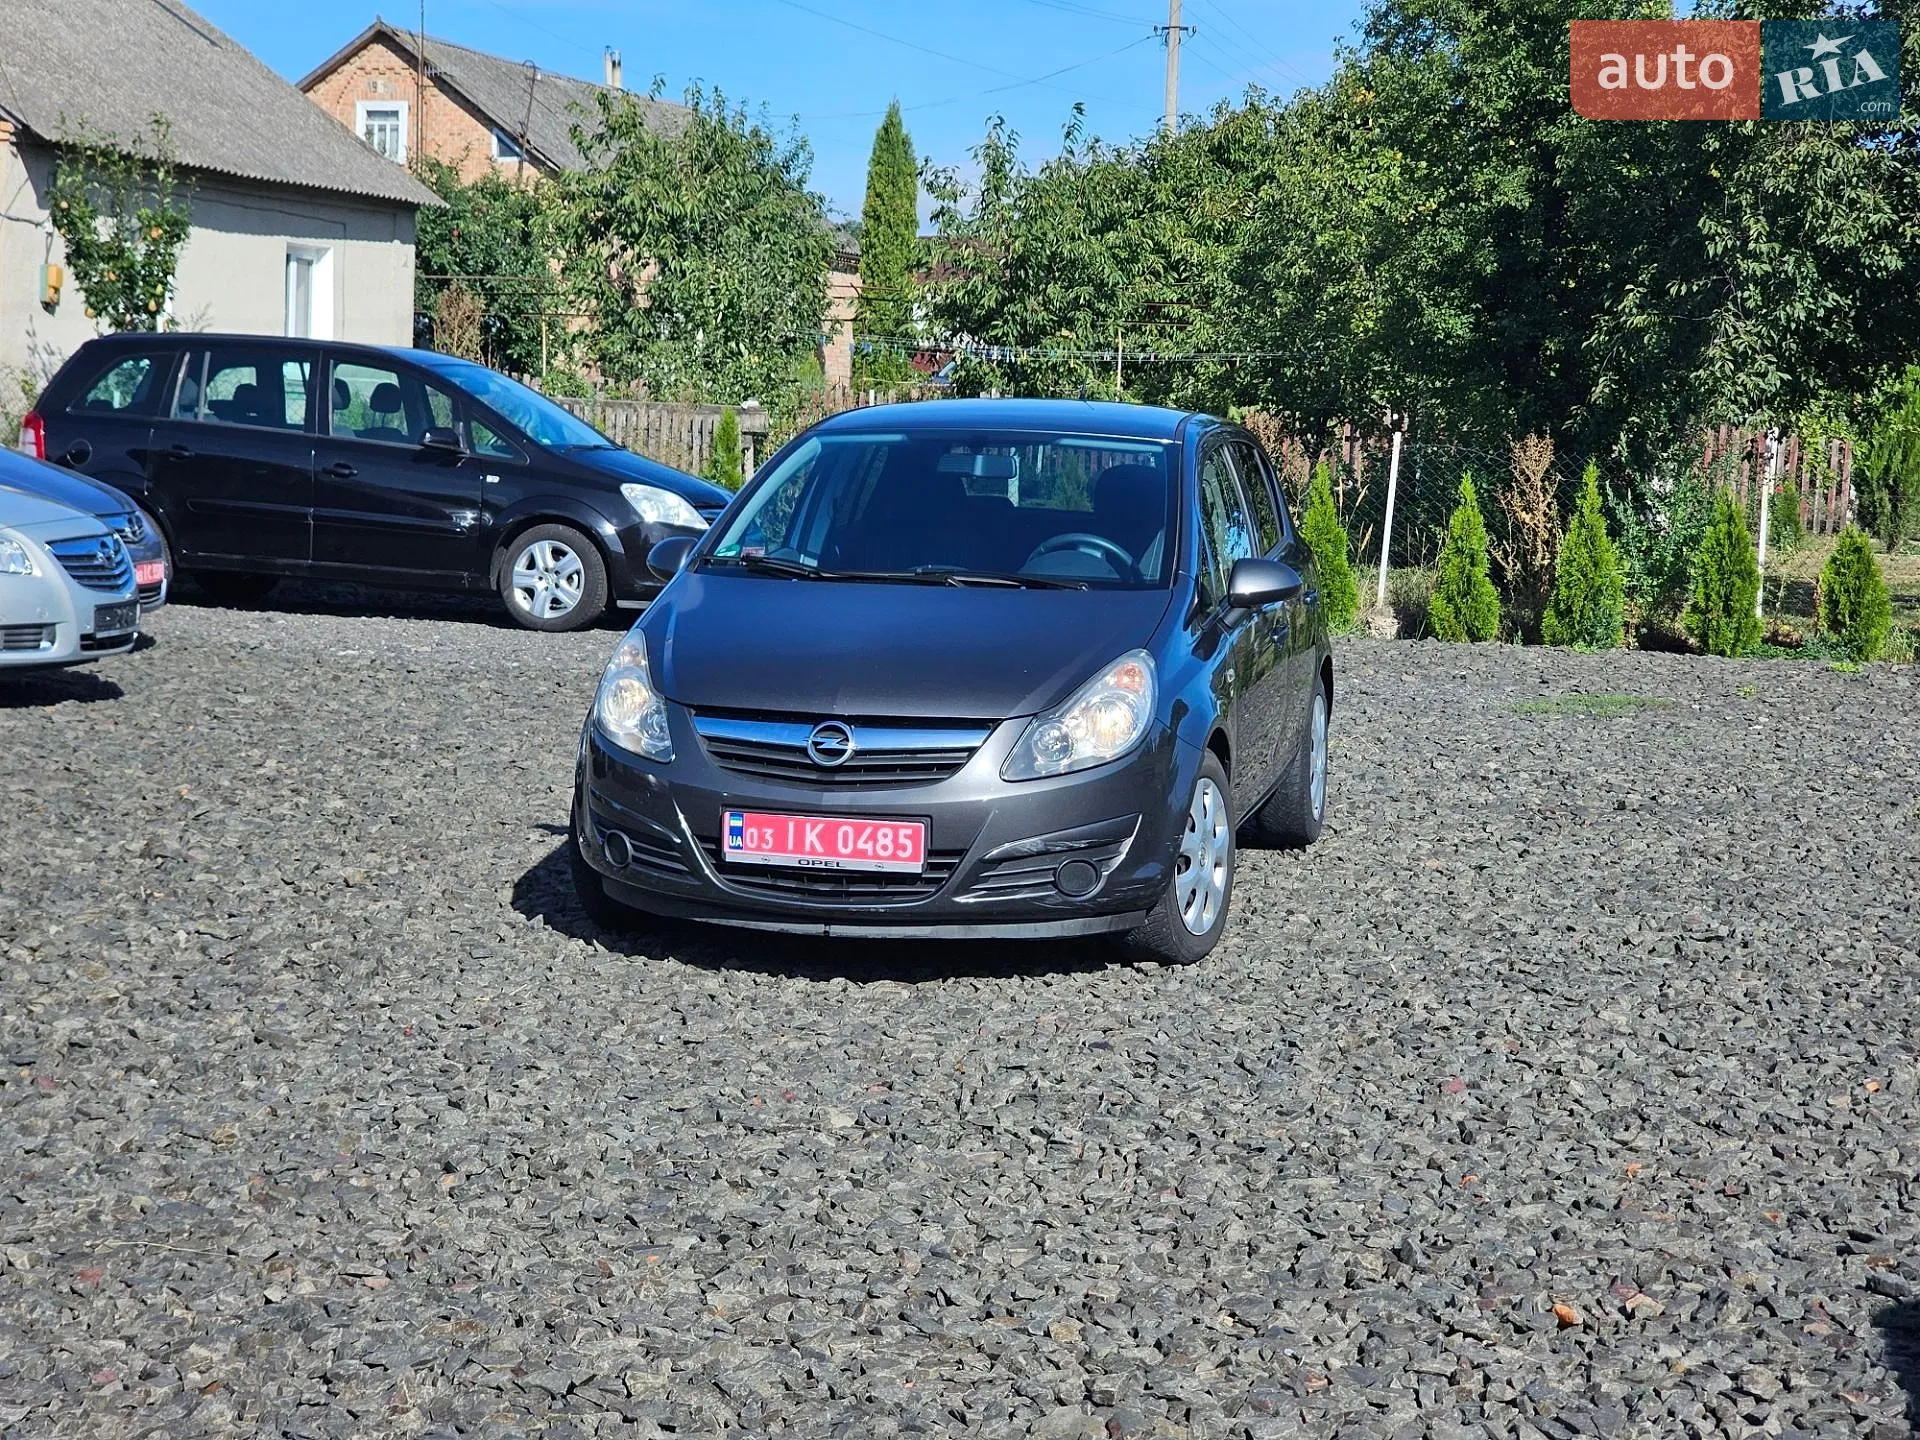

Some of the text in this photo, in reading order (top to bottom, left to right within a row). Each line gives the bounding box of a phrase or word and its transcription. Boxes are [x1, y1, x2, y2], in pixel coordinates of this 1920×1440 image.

[729, 835, 743, 847] UA
[746, 821, 912, 858] 03 IK 0485
[798, 859, 846, 868] OPEL
